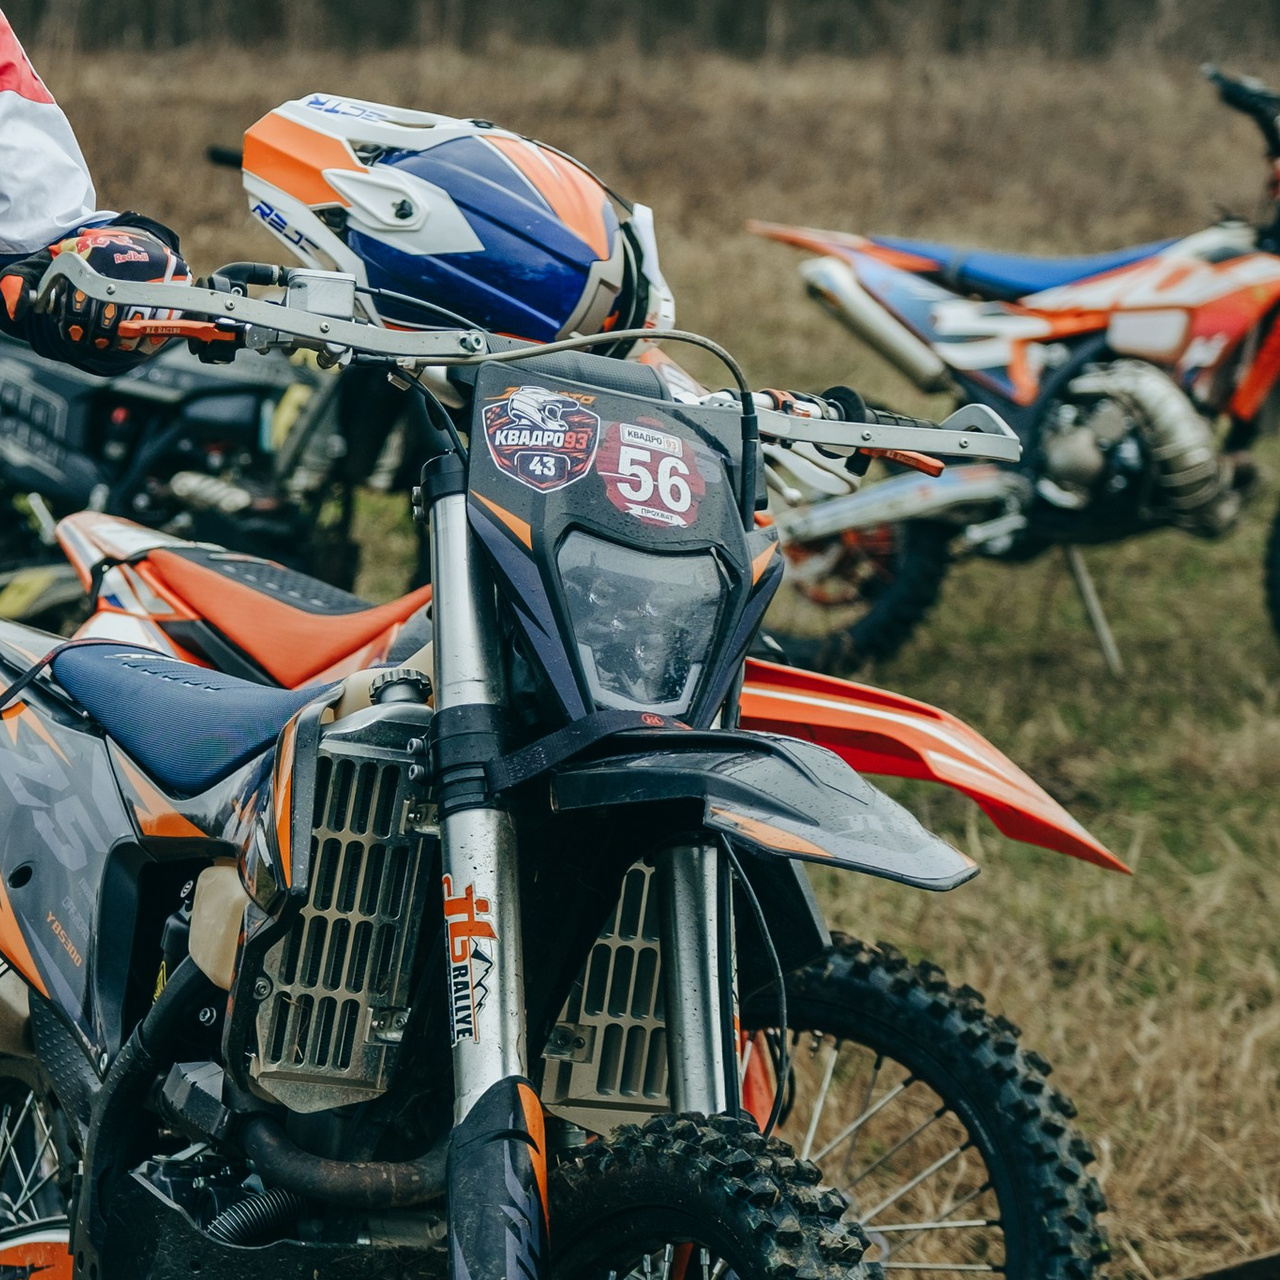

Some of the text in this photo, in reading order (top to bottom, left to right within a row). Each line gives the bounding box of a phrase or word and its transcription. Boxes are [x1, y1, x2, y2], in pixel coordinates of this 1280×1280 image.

[627, 430, 663, 446] КВАДРО
[529, 457, 556, 477] 43
[617, 446, 692, 513] 56
[640, 507, 675, 521] ПРОХВАТ
[46, 910, 83, 968] YBS300
[452, 964, 474, 1040] RALLYE
